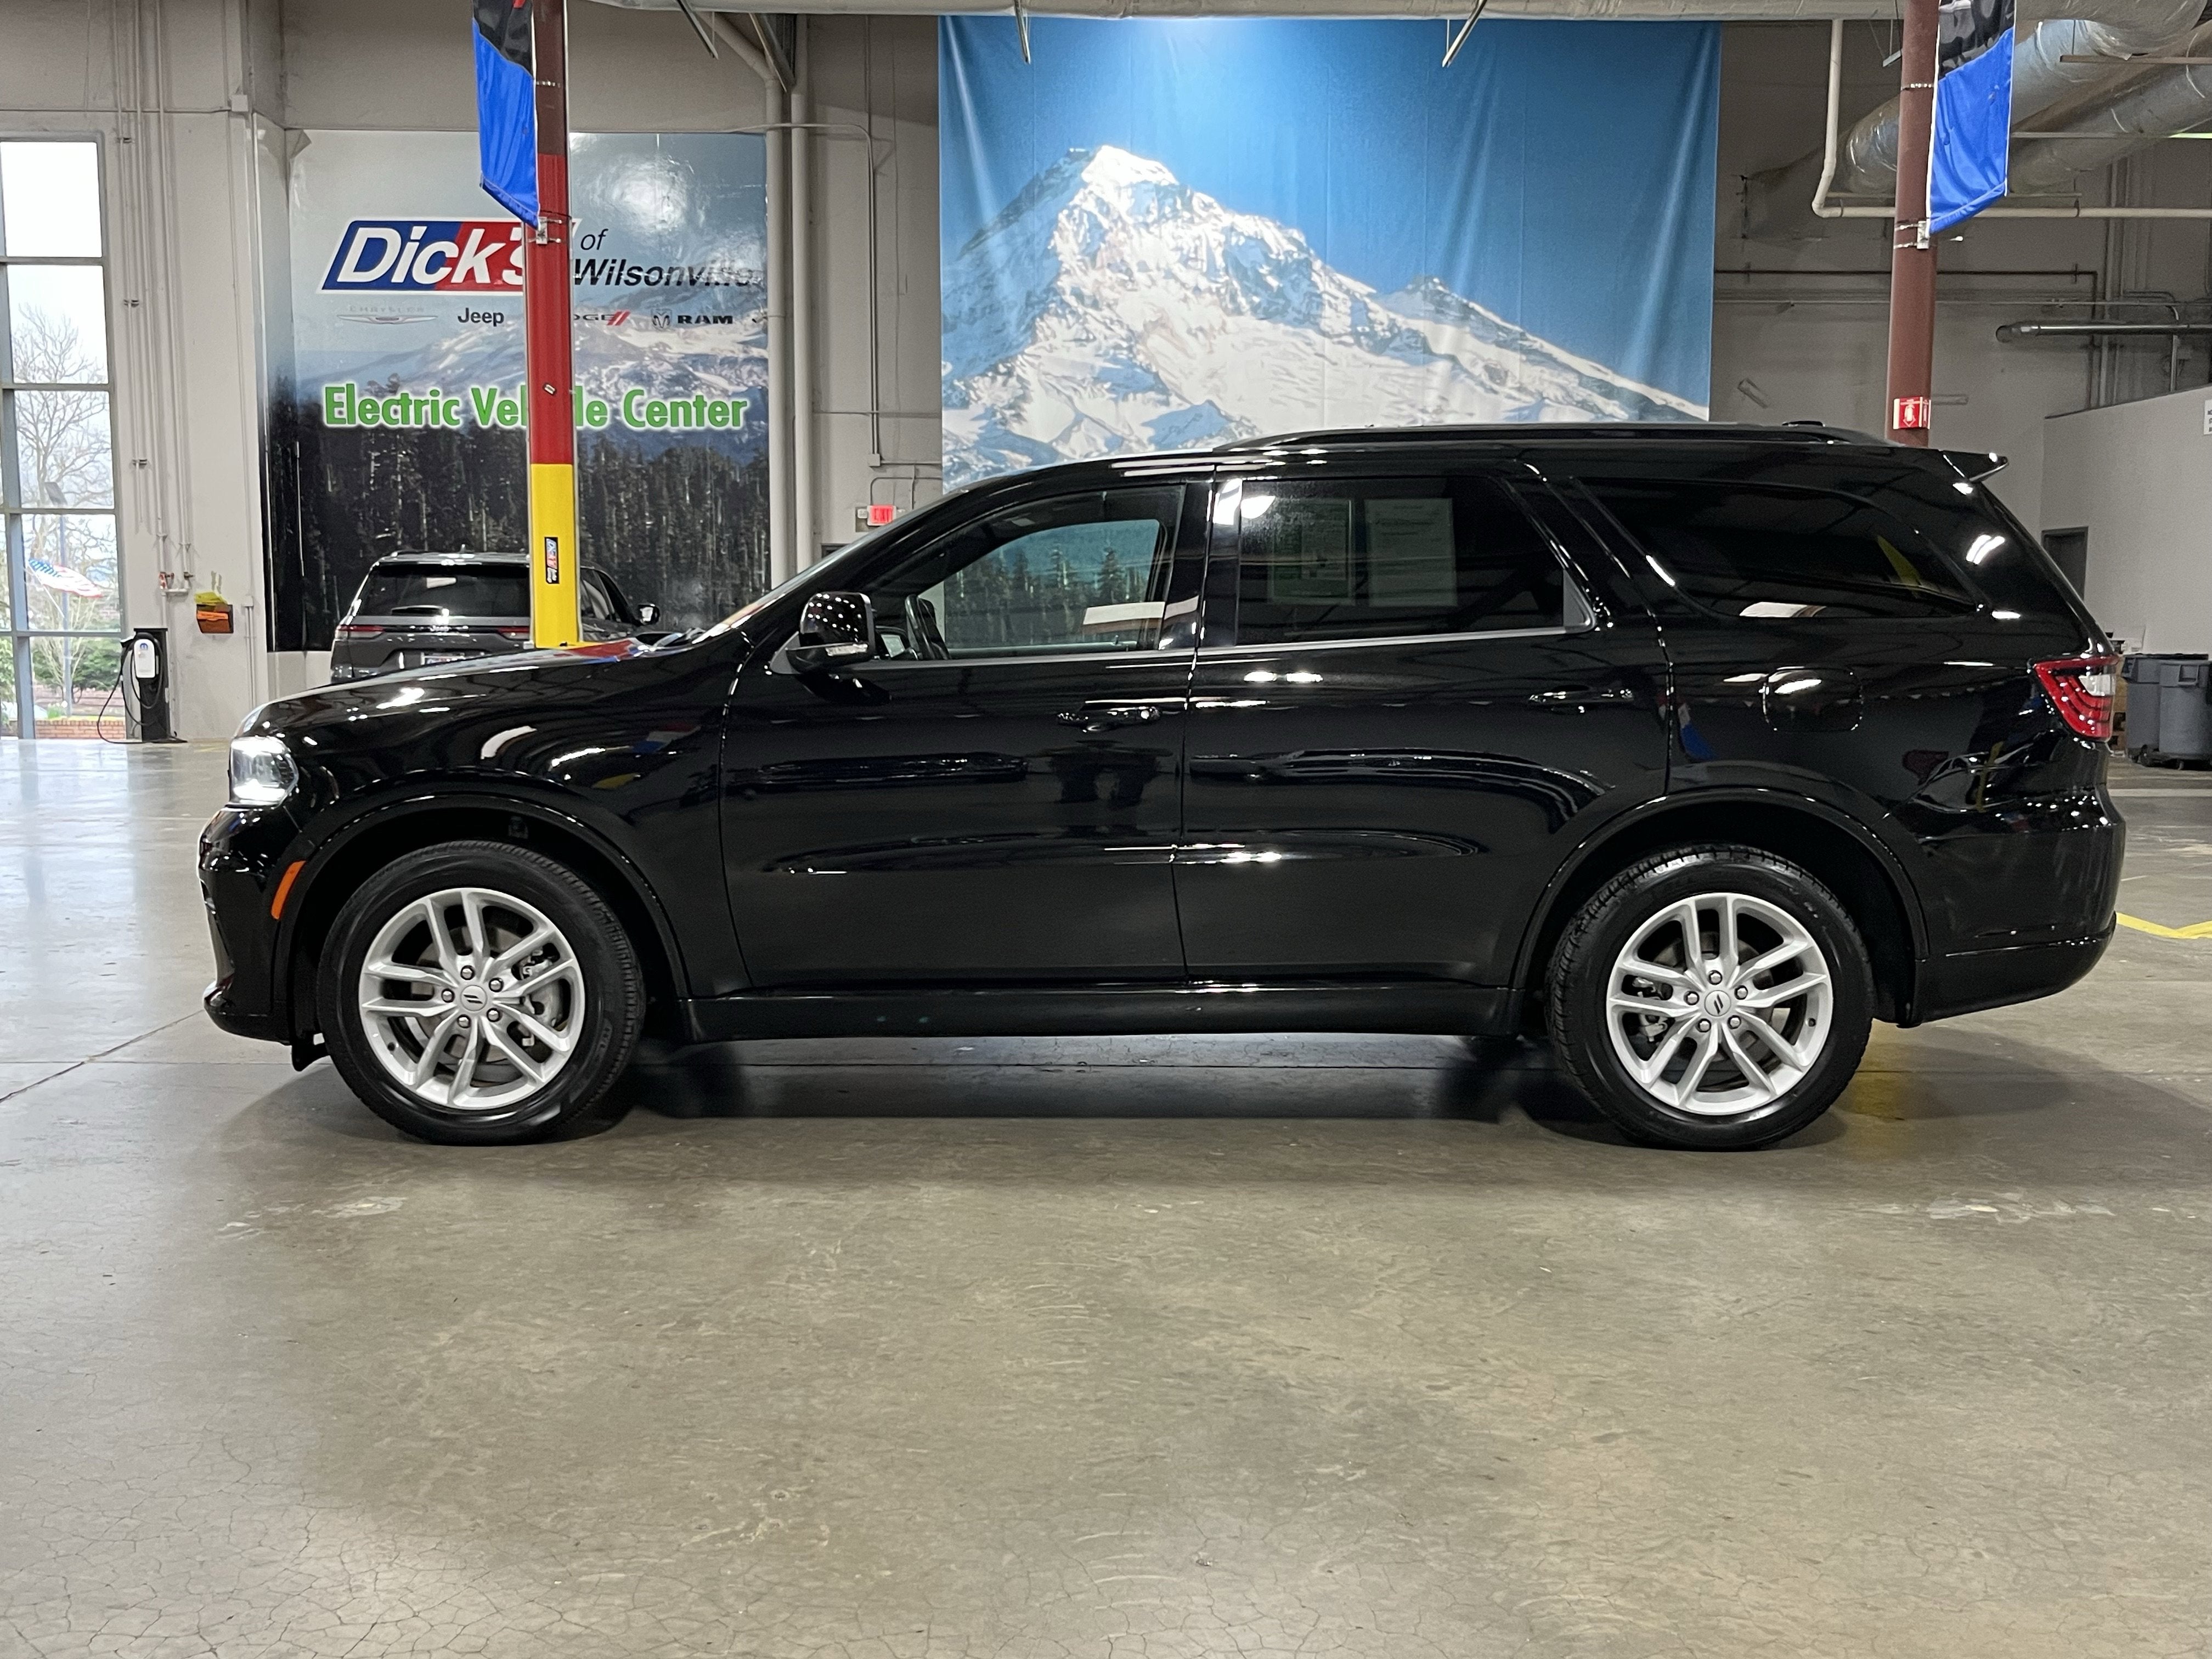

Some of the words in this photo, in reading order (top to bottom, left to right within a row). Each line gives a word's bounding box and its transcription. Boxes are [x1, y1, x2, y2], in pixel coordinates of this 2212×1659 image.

[580, 229, 608, 250] of
[458, 307, 504, 326] Jeep
[678, 315, 733, 324] RAM
[325, 383, 460, 426] Electric
[471, 386, 607, 427] Vele
[624, 389, 747, 427] Center
